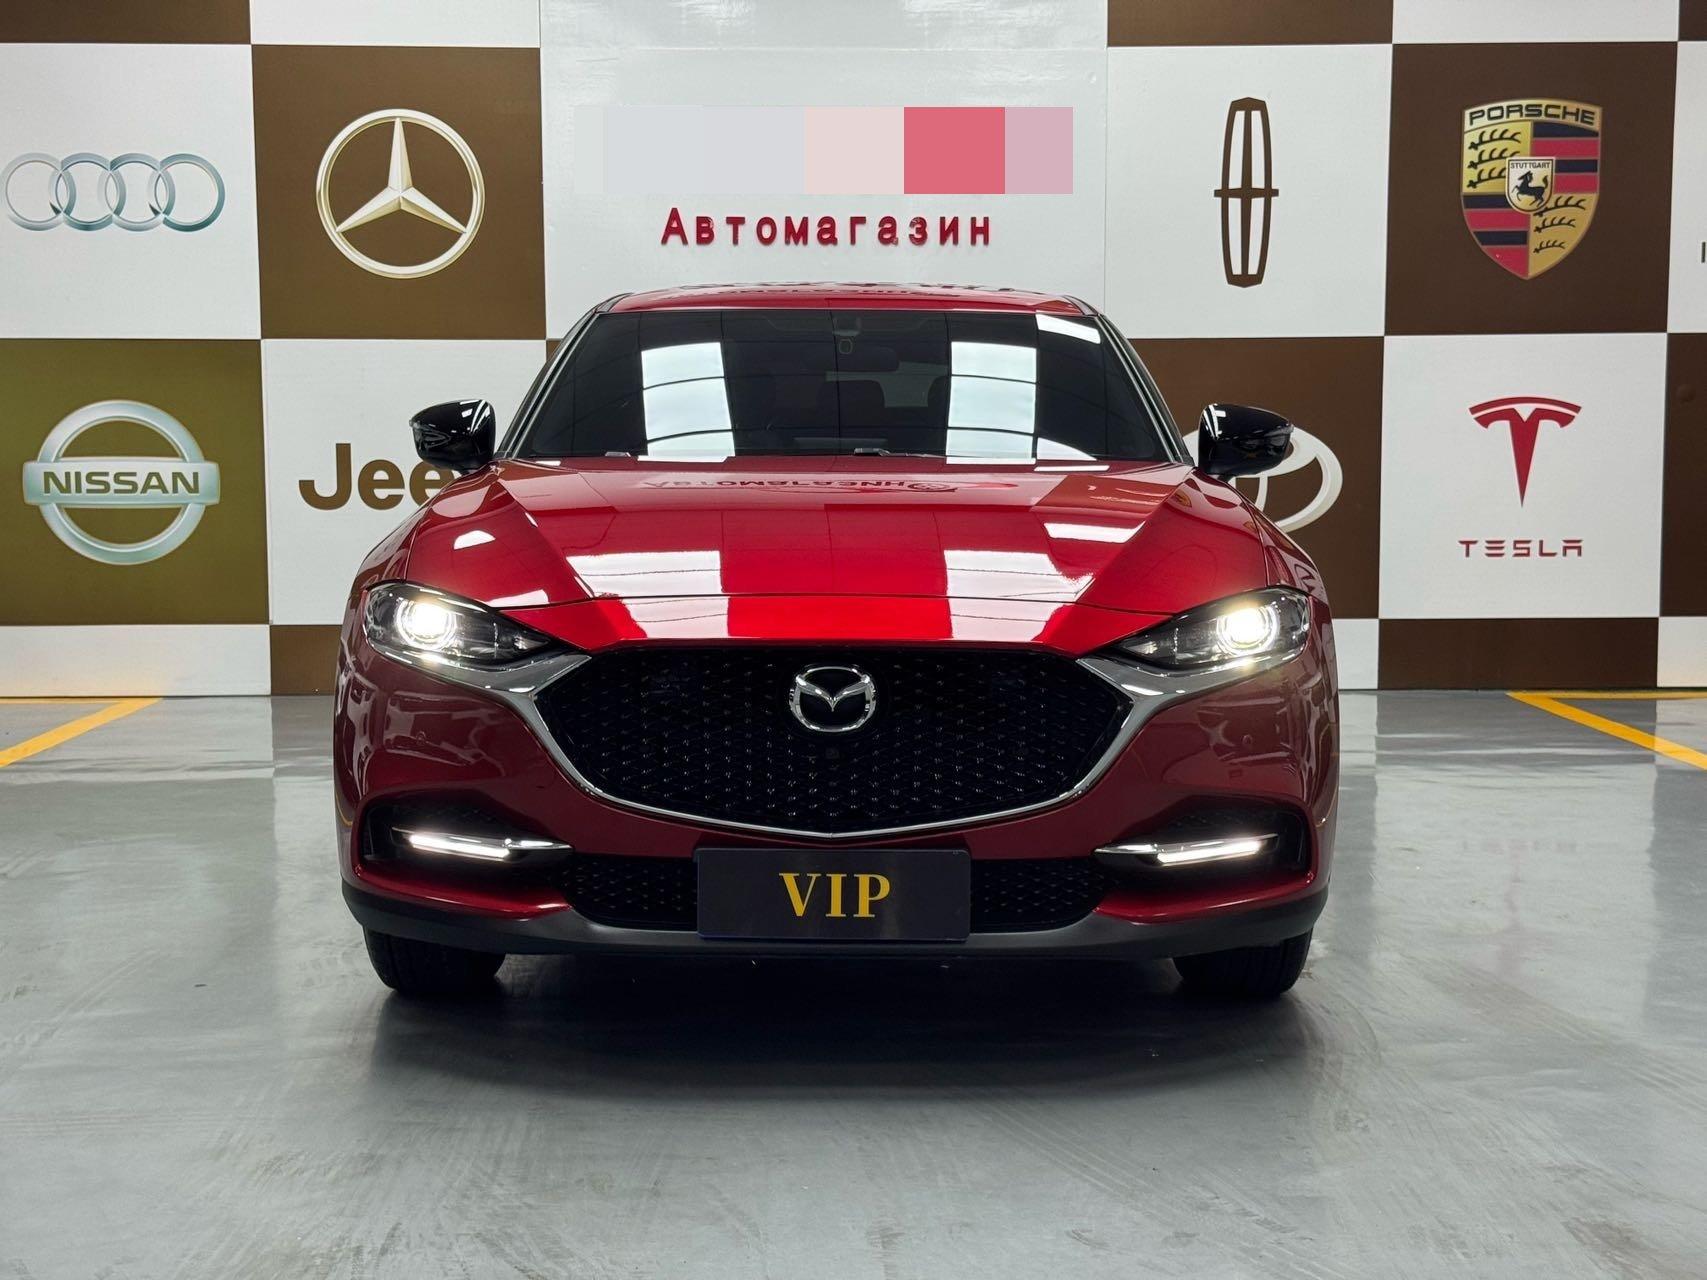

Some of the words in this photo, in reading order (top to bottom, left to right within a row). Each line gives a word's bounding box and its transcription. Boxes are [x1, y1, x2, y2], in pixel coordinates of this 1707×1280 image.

[1469, 104, 1595, 126] PORSCHE
[661, 207, 990, 246] Автомагазин
[43, 471, 200, 494] NISSAN
[298, 443, 456, 510] Jee
[1458, 539, 1583, 558] TESLA
[778, 872, 891, 918] VIP
